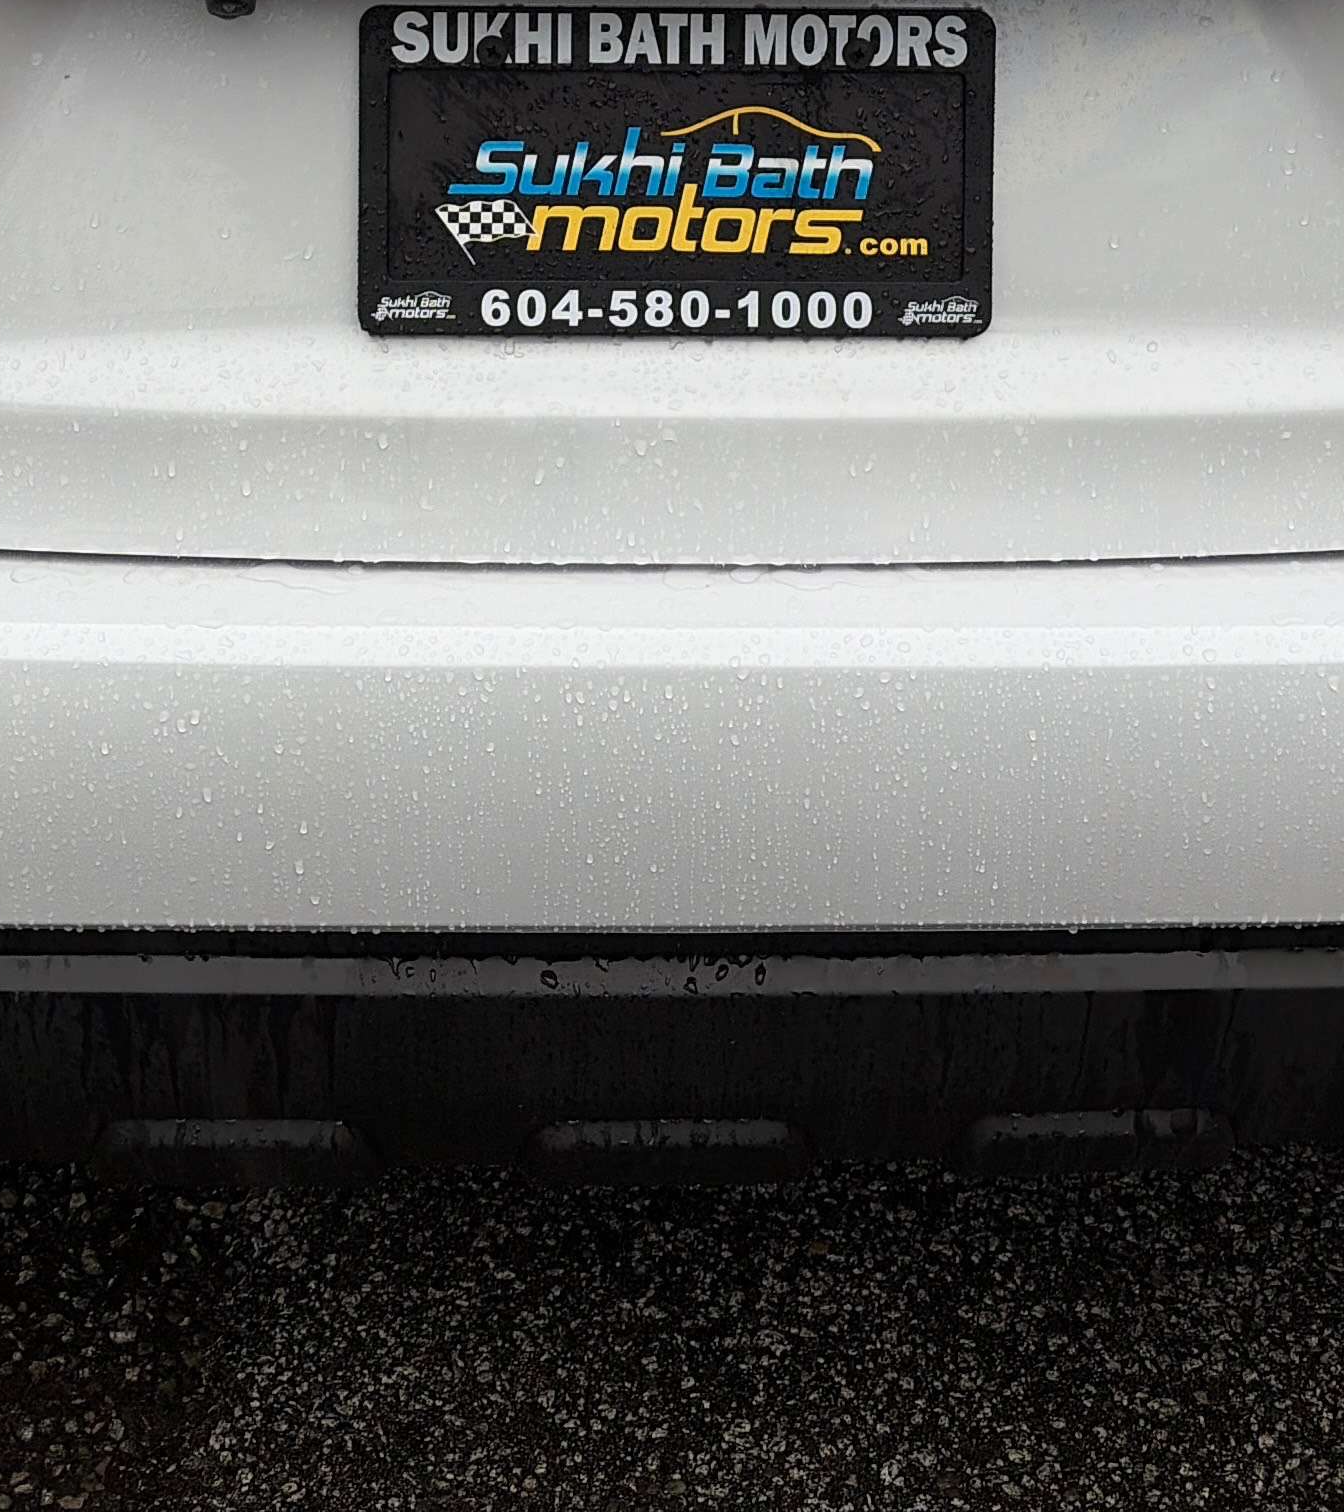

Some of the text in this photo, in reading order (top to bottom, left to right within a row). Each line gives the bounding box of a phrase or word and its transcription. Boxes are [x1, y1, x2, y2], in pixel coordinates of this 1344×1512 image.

[391, 11, 968, 68] SUKHI BATH MOTORS
[447, 126, 875, 201] Sukhi Bath
[480, 289, 874, 330] 604-580-1000
